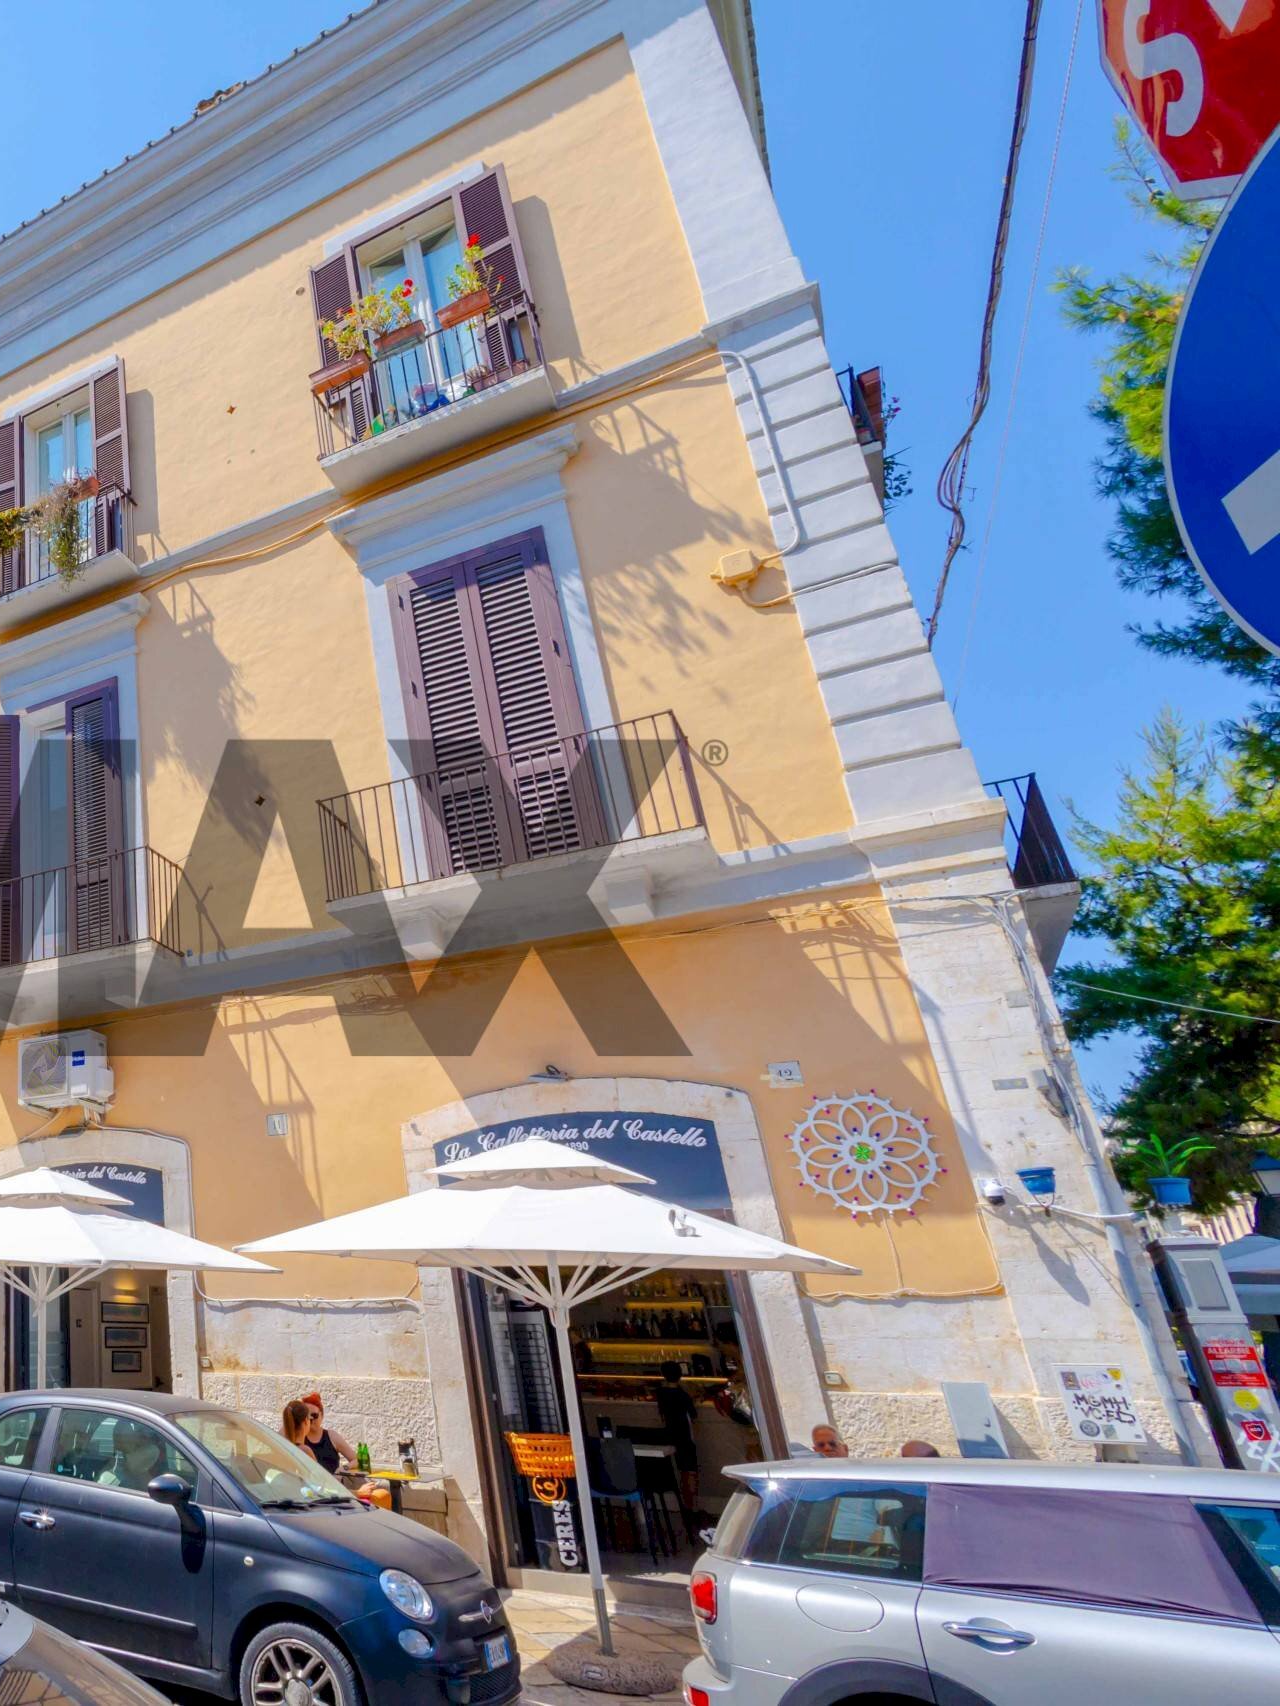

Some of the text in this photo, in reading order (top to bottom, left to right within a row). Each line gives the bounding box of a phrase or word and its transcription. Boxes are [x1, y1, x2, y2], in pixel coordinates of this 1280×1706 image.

[444, 1143, 470, 1164] La
[584, 1119, 619, 1140] del
[623, 1120, 708, 1148] Castello
[88, 1166, 105, 1179] del
[107, 1166, 147, 1184] Castello
[552, 1500, 578, 1567] CERES
